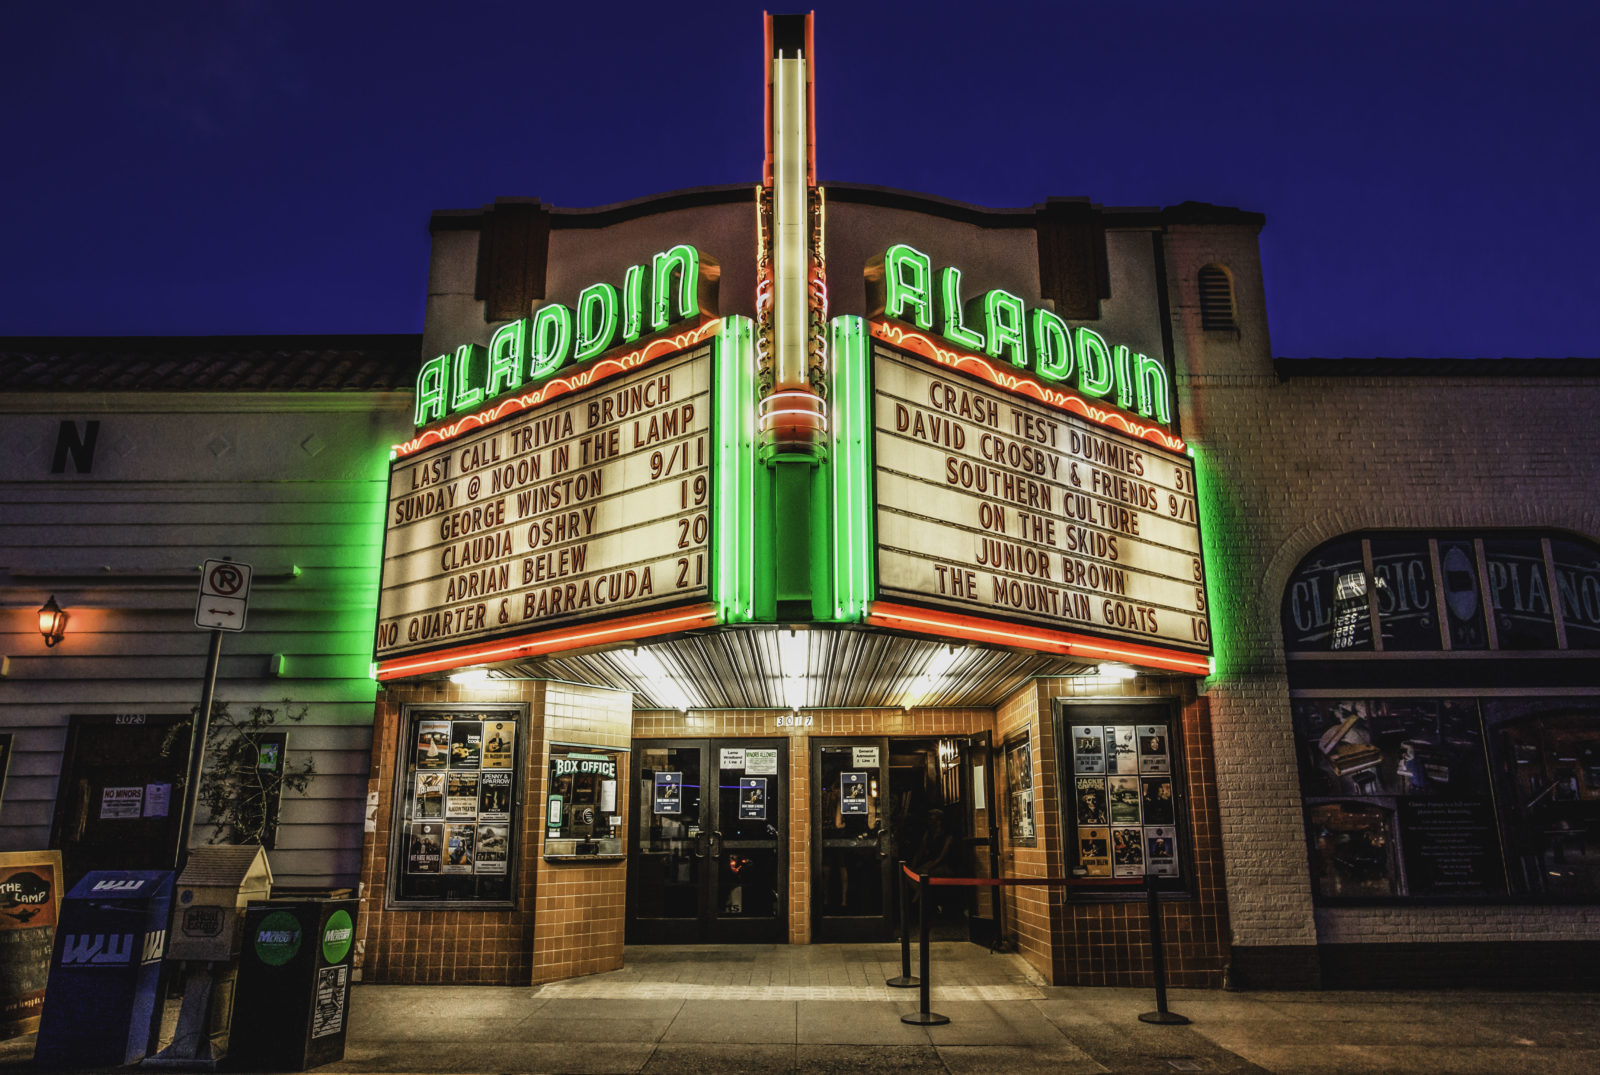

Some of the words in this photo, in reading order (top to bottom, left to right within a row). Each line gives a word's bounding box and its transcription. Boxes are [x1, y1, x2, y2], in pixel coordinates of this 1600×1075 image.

[414, 244, 700, 427] ALADDIN
[885, 244, 1171, 424] ALADDIN
[50, 420, 101, 474] N
[395, 483, 458, 524] SUNDAY
[467, 476, 481, 499] @
[492, 457, 540, 493] NOON
[552, 445, 569, 475] IN
[581, 428, 619, 465] THE
[633, 405, 694, 448] LAMP
[412, 456, 451, 489] LAST
[460, 438, 500, 473] CALL
[511, 412, 573, 454] TRIVIA
[588, 374, 671, 429] BRUNCH
[896, 403, 965, 450] DAVID
[980, 433, 1059, 480] CROSBY
[1070, 462, 1081, 486] &
[1093, 469, 1157, 510] FRIENDS
[1168, 494, 1195, 523] 9/1
[929, 381, 998, 427] CRASH
[1011, 408, 1059, 447] TEST
[1070, 430, 1144, 477] DUMMIES
[1175, 468, 1192, 493] 31
[441, 499, 505, 540] GEORGE
[518, 469, 602, 518] WINSTON
[651, 437, 704, 479] 9/11
[441, 531, 512, 571] CLAUDIA
[528, 507, 596, 548] OSHRY
[681, 475, 706, 510] 19
[946, 456, 1051, 511] SOUTHERN
[1063, 493, 1139, 535] CULTURE
[446, 564, 509, 603] ADRIAN
[522, 544, 588, 584] BELEW
[678, 514, 707, 549] 20
[976, 539, 1050, 579] JUNIOR
[1062, 557, 1125, 595] BROWN
[1195, 588, 1204, 611] 5
[979, 502, 1005, 534] ON
[1018, 512, 1055, 546] THE
[1067, 525, 1118, 560] SKIDS
[1192, 558, 1201, 581] 3
[378, 622, 398, 648] NO
[408, 603, 486, 642] QUARTER
[499, 598, 509, 623] &
[523, 567, 652, 619] BARRACUDA
[676, 555, 703, 588] 21
[935, 564, 978, 600] THE
[992, 576, 1091, 620] MOUNTAIN
[1102, 602, 1158, 633] GOATS
[1191, 618, 1207, 642] 10
[1291, 560, 1430, 632] CLSIC
[104, 790, 114, 798] NO
[116, 789, 141, 798] MINORS
[556, 759, 578, 776] BOX
[581, 761, 615, 777] OFFICE
[0, 883, 22, 894] THE
[15, 891, 46, 904] LAMP
